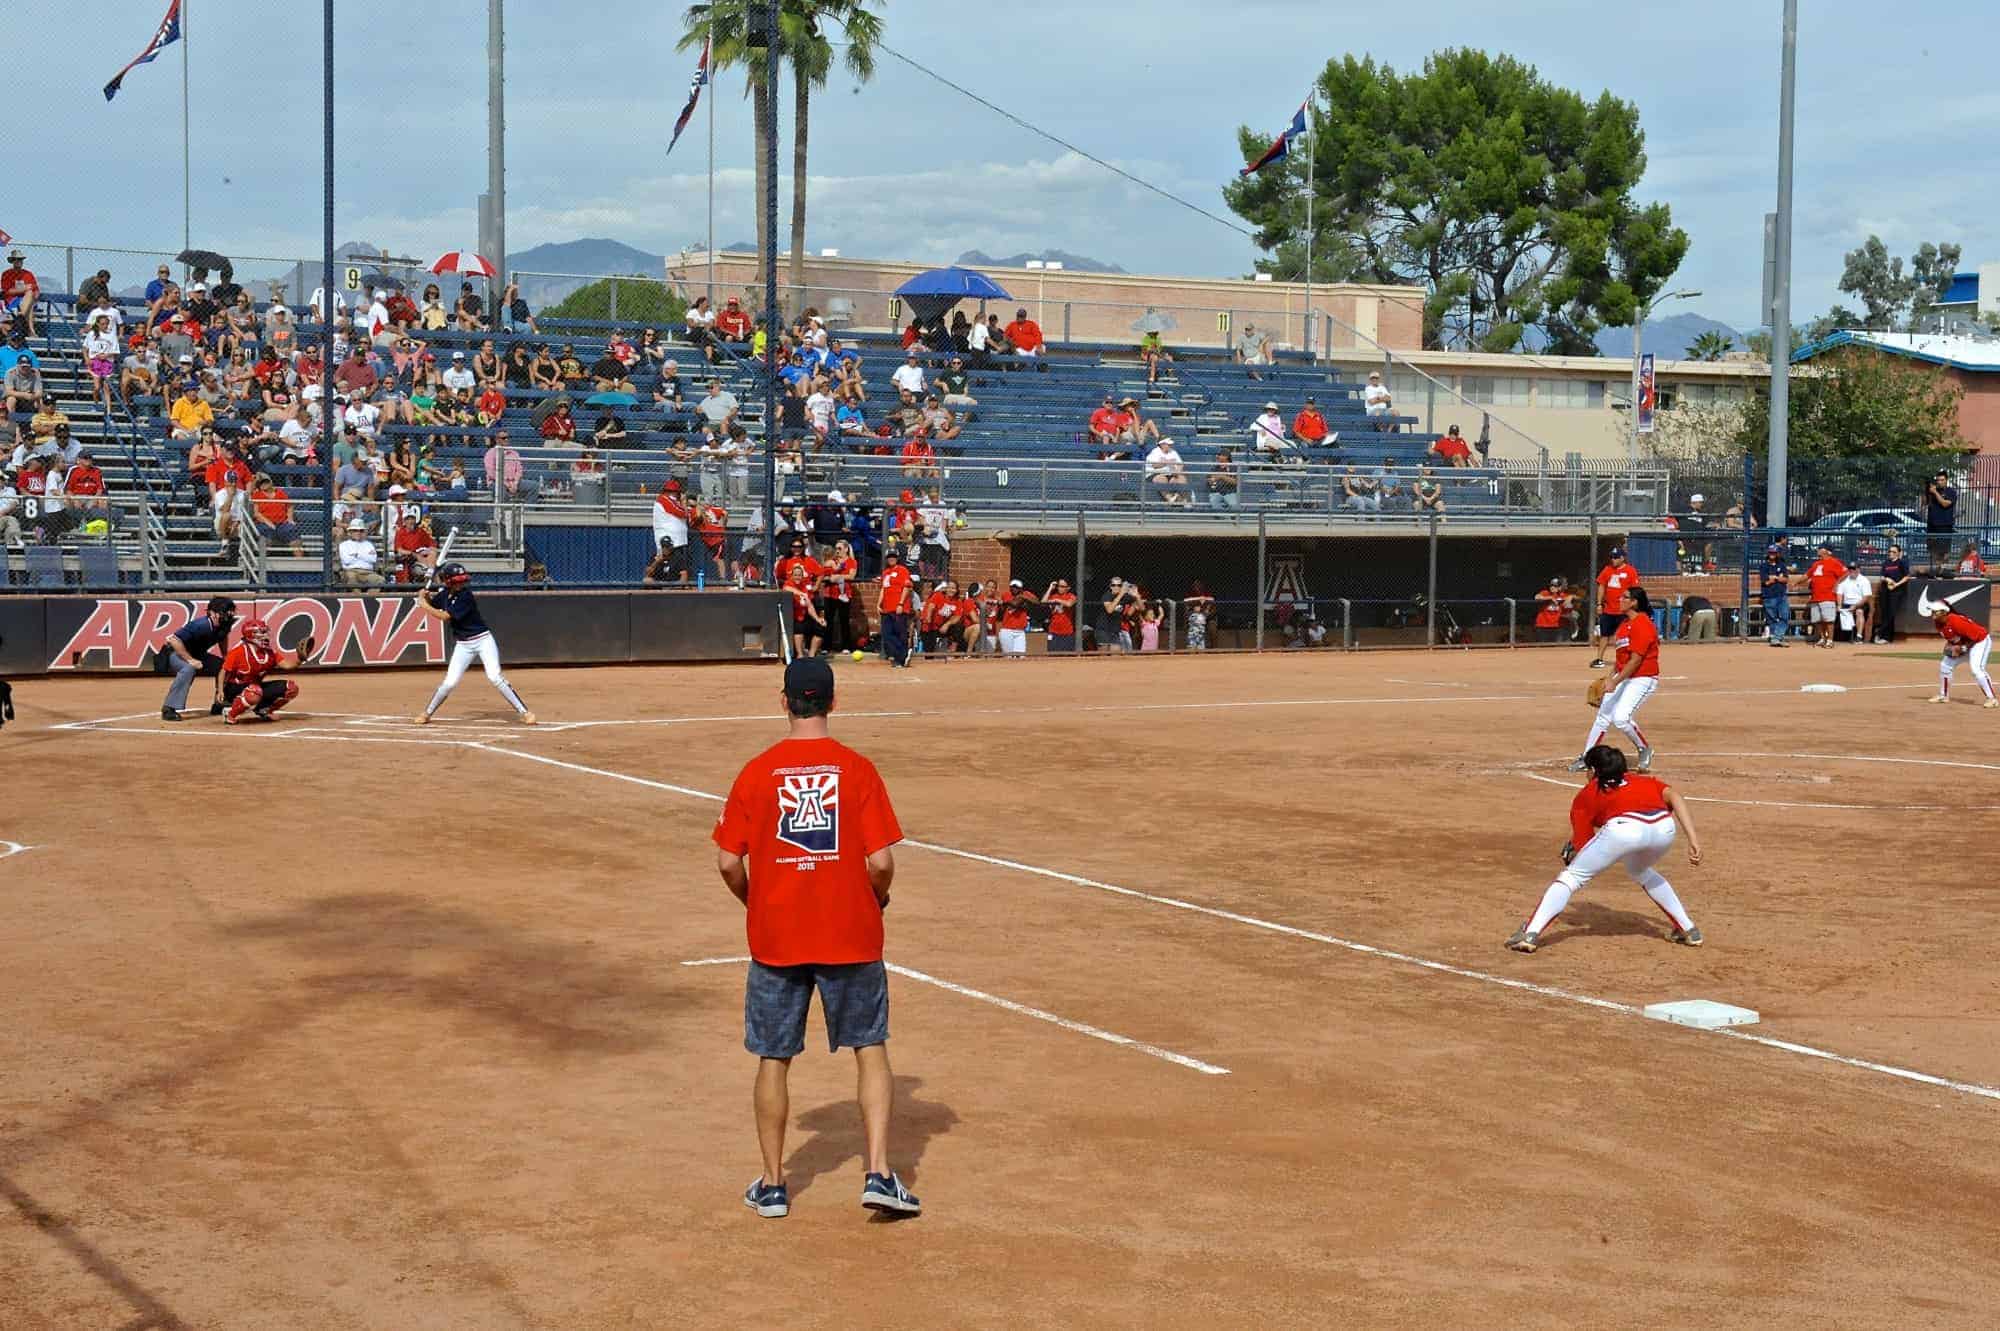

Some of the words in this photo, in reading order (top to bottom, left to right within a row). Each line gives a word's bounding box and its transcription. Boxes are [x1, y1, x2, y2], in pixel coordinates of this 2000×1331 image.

[348, 268, 358, 289] 9
[890, 299, 901, 318] 10
[1218, 313, 1228, 331] 11
[996, 469, 1008, 486] 10
[1488, 479, 1498, 495] 11
[25, 498, 38, 519] 8
[790, 789, 831, 832] A
